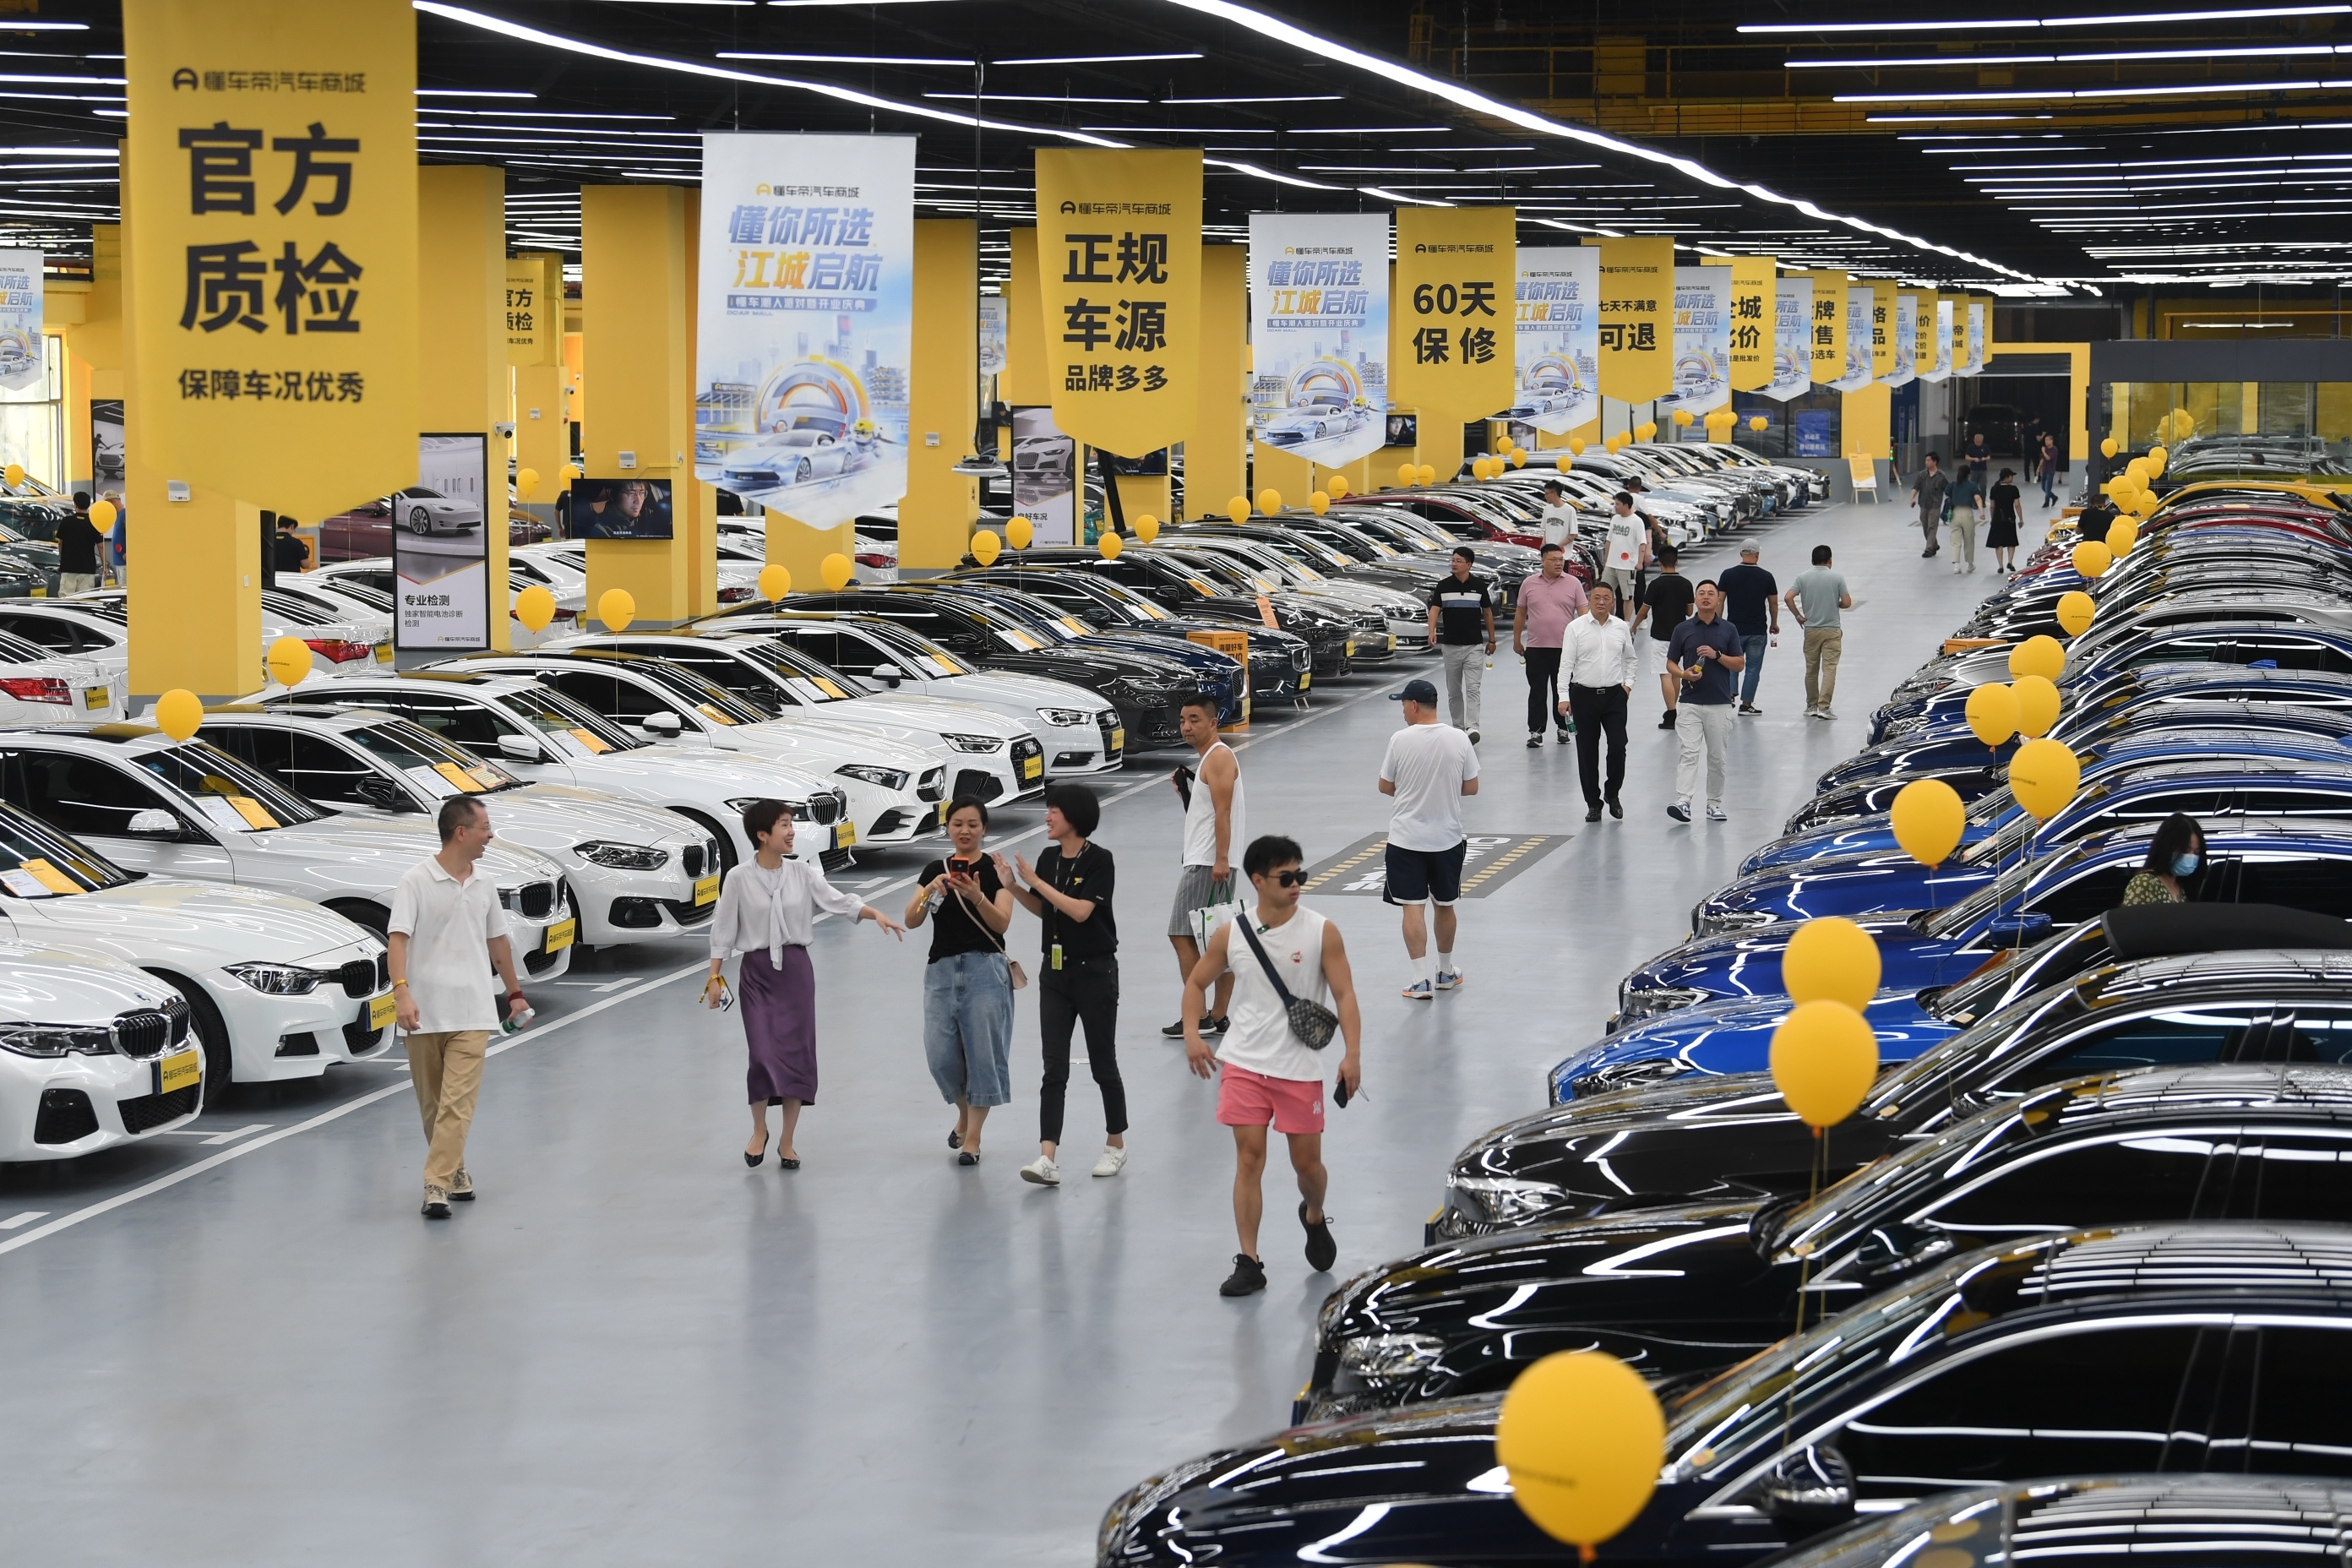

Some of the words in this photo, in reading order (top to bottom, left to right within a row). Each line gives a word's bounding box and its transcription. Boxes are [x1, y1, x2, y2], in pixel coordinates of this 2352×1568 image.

[204, 70, 367, 94] 懂车帝汽车商城
[178, 121, 361, 218] 官方
[772, 185, 860, 199] 懂车帝汽车商城
[1078, 202, 1172, 215] 懂车帝汽车商城
[727, 204, 874, 247] 懂你所选
[1063, 231, 1168, 286] 正规
[1295, 247, 1353, 255] 懂车帝汽车商城
[1428, 244, 1494, 253] 懂车帝汽车商城
[732, 250, 884, 291] 江城启航
[1267, 260, 1363, 286] 懂你所选
[178, 241, 364, 335] 质检
[1413, 282, 1497, 318] 60天
[1271, 289, 1369, 314] 江城启航
[1598, 299, 1658, 313] 七天不满意
[1812, 300, 1835, 321] 牌
[1063, 297, 1168, 352] 车源
[1673, 310, 1719, 326] 城启航
[1916, 315, 1930, 328] 价
[1412, 327, 1497, 365] 保修
[1598, 323, 1657, 351] 可退
[1811, 325, 1834, 346] 售
[178, 368, 364, 404] 保障车况优秀
[1065, 364, 1169, 392] 品牌多多
[405, 594, 449, 607] 专业检测
[404, 609, 464, 618] 独家智能电池诊断
[404, 619, 420, 628] 检测
